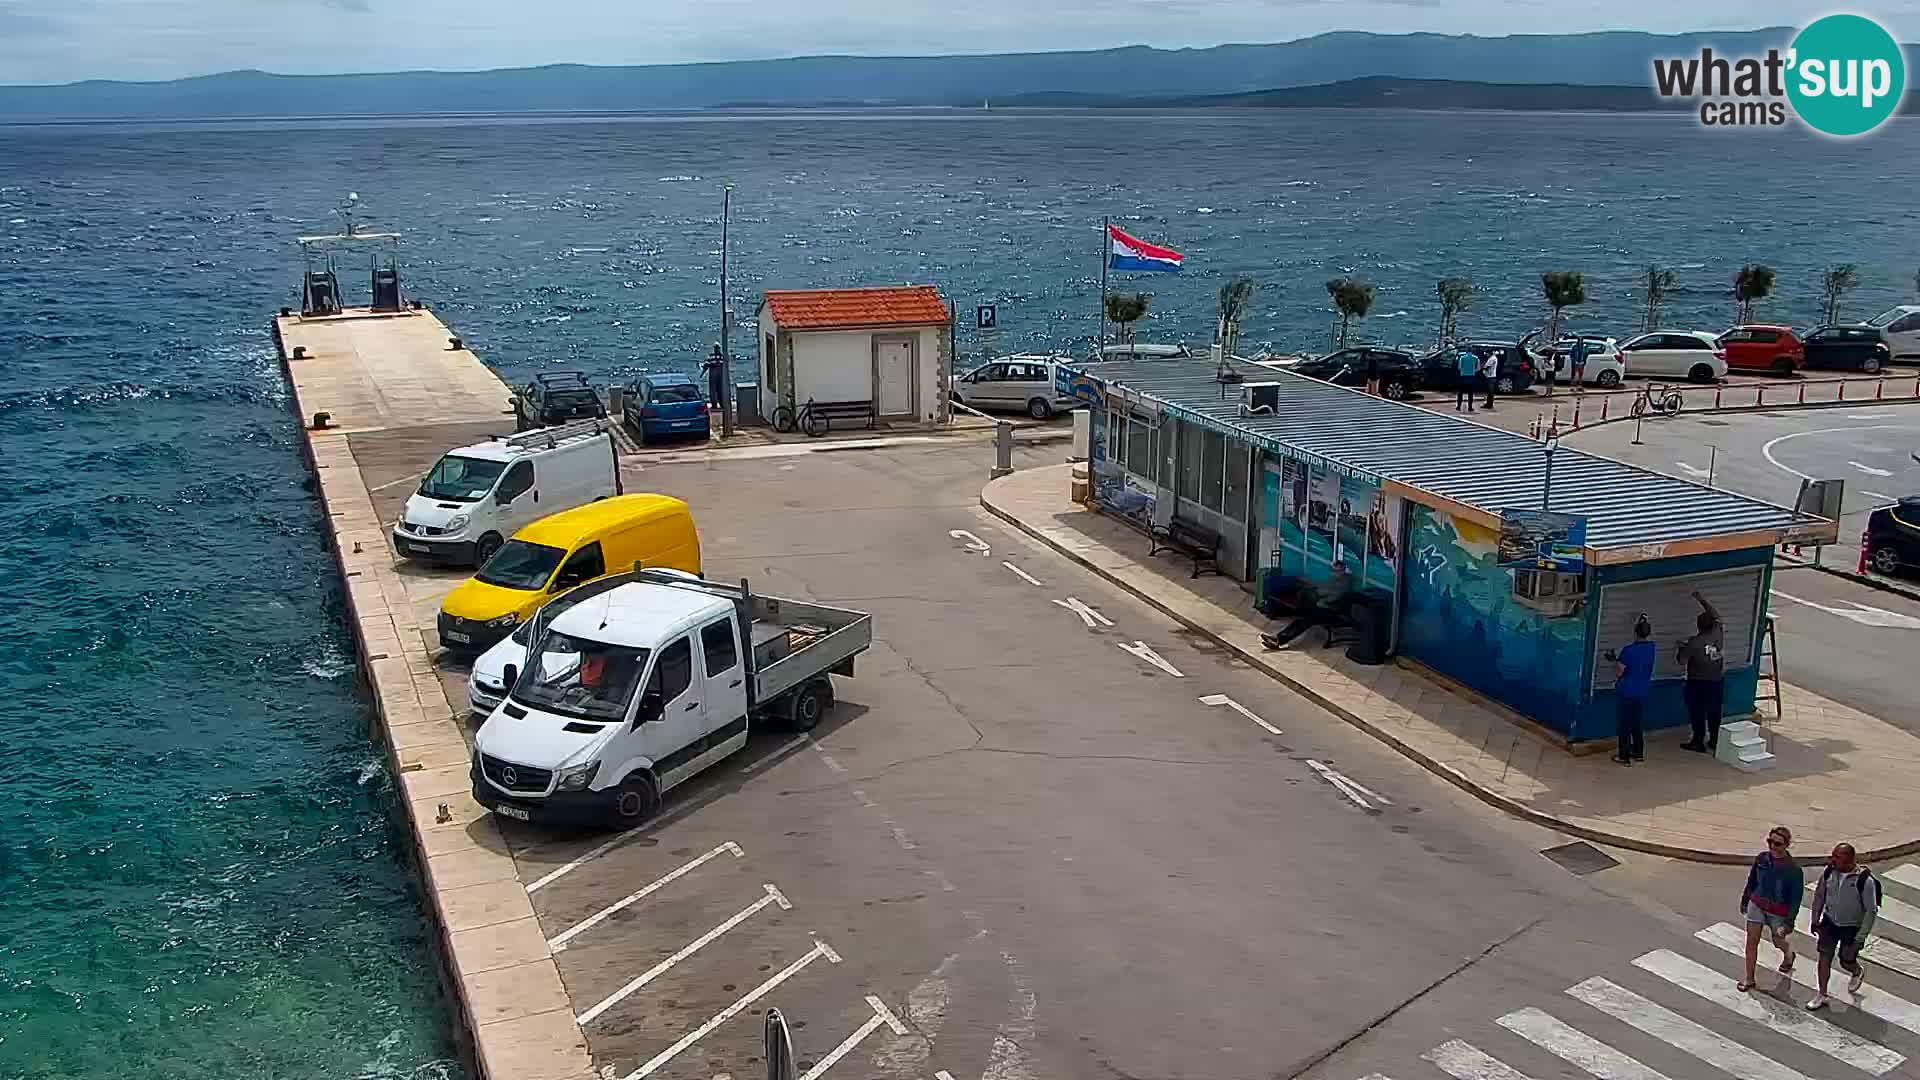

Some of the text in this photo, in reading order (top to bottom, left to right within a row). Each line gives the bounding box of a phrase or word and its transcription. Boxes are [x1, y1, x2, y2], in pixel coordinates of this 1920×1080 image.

[982, 308, 992, 325] P
[1294, 448, 1323, 468] STATION
[1327, 460, 1350, 477] TICKET
[1352, 469, 1377, 486] OFFICE
